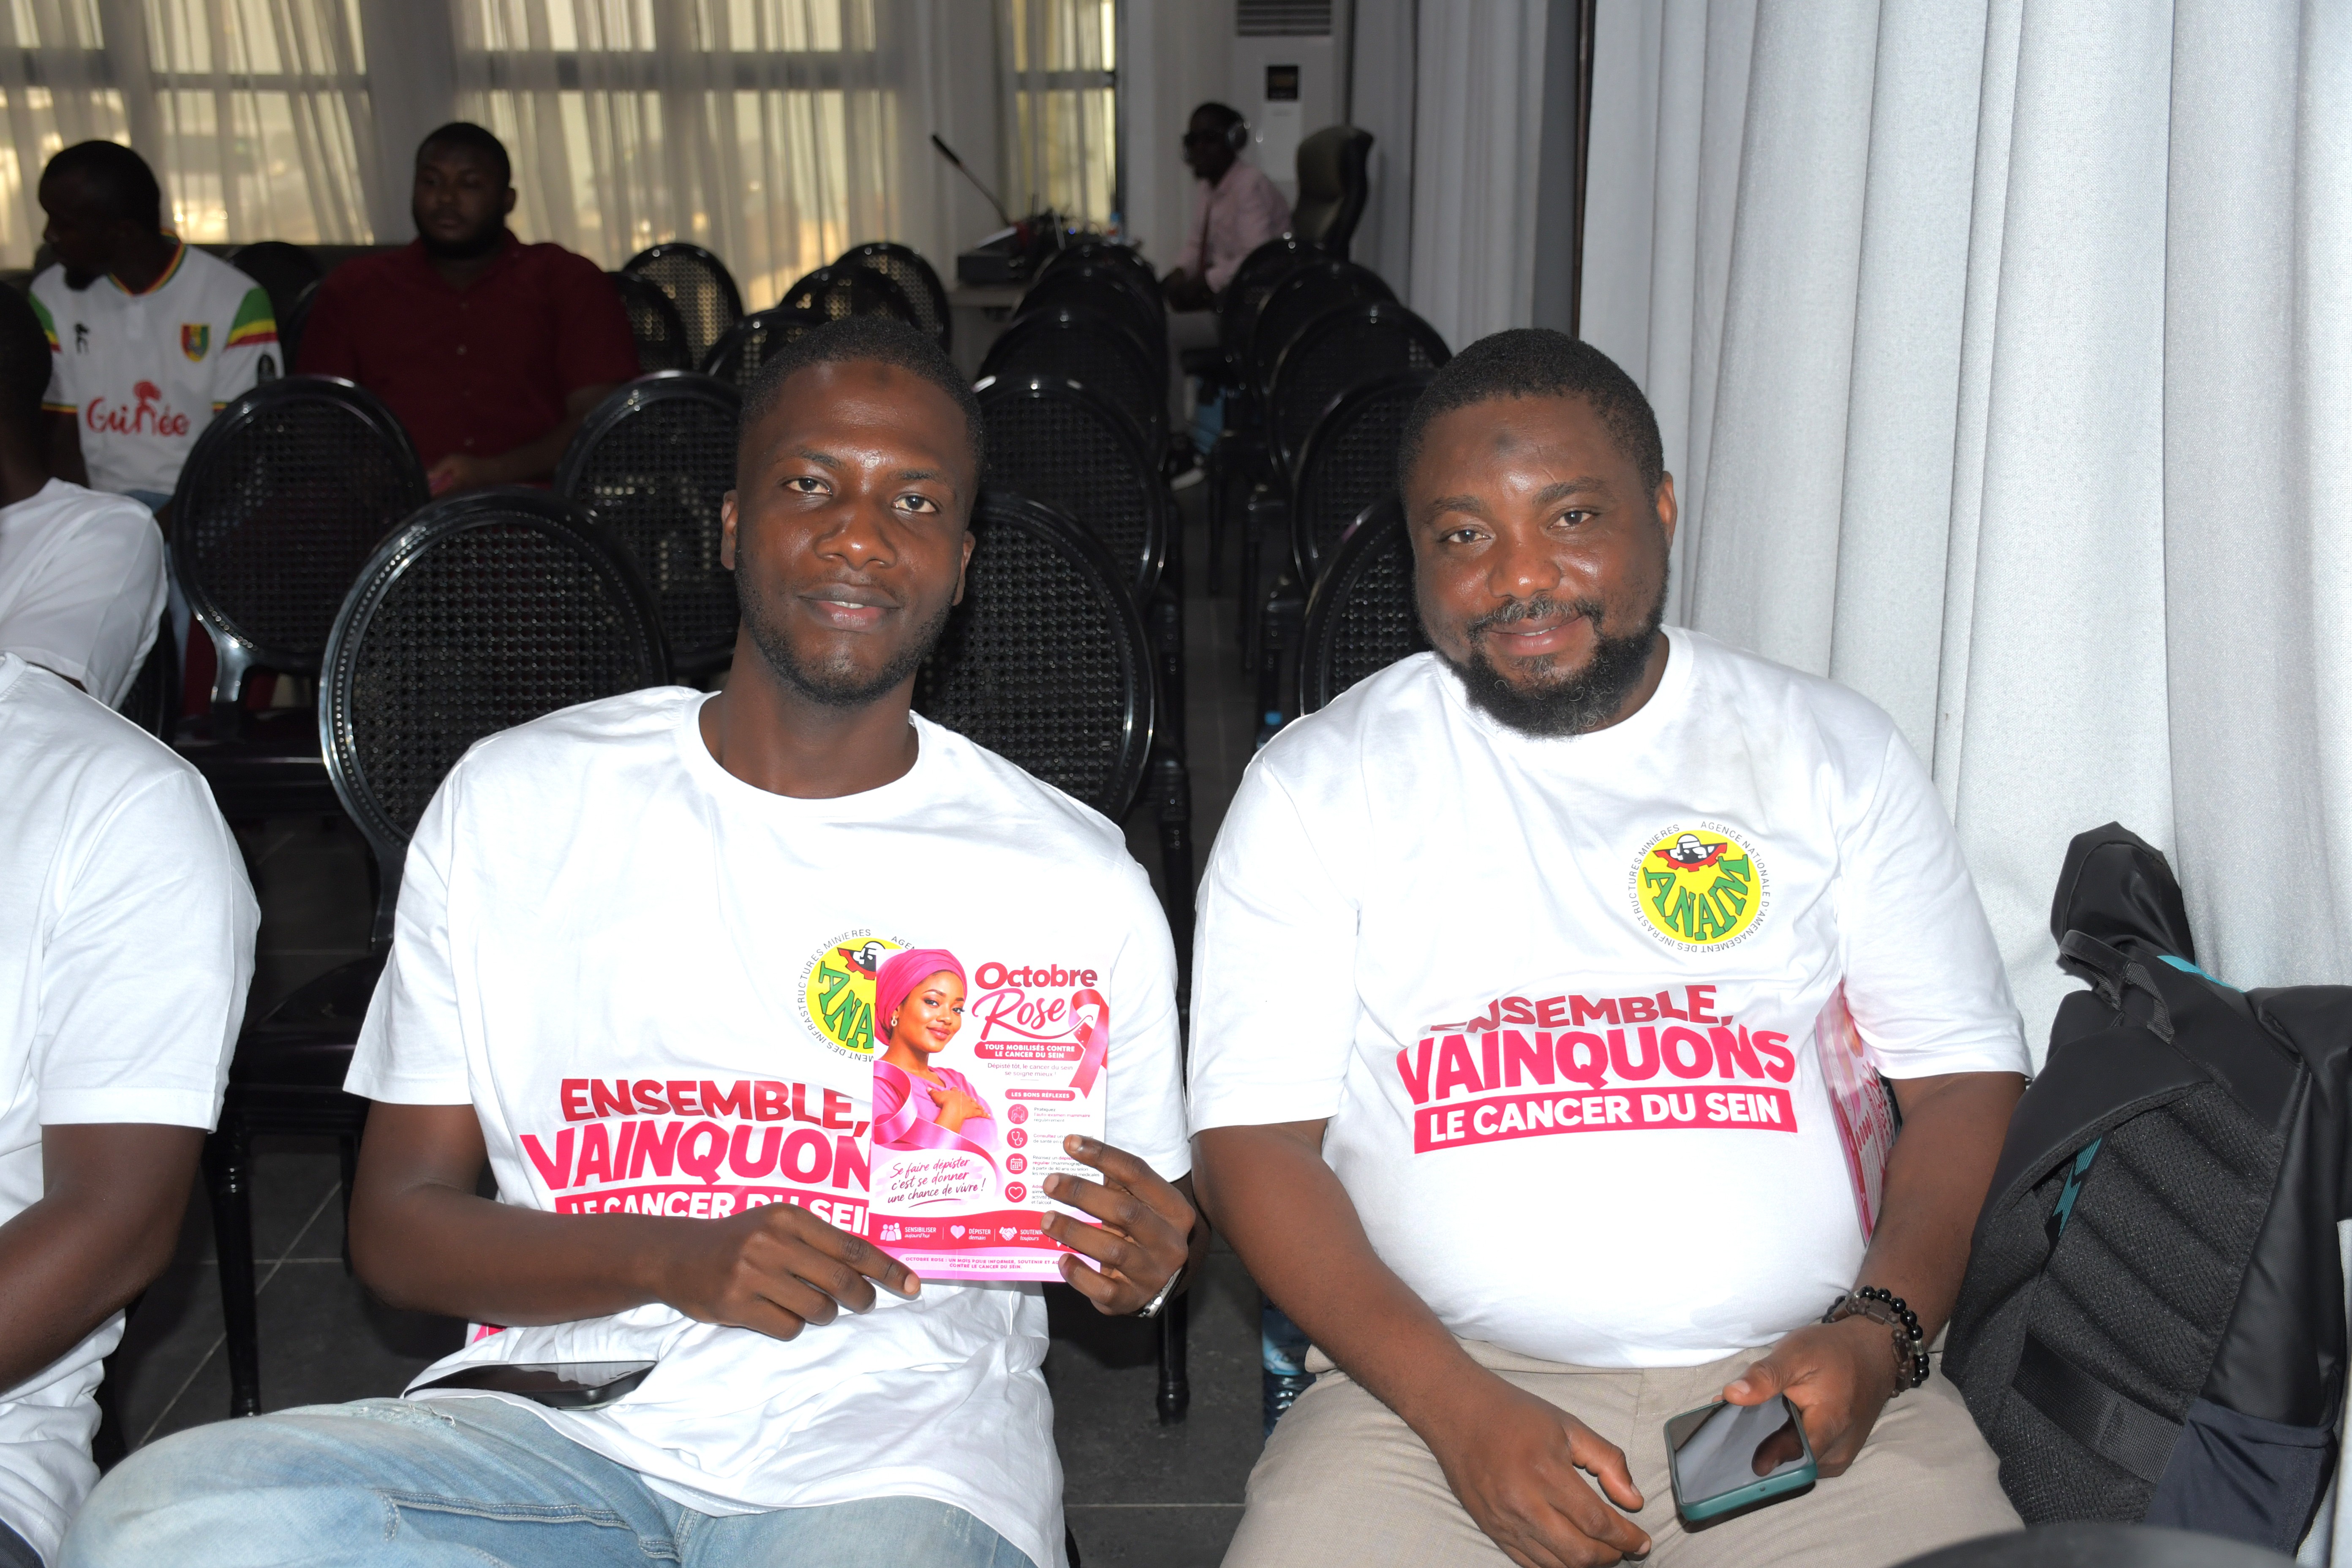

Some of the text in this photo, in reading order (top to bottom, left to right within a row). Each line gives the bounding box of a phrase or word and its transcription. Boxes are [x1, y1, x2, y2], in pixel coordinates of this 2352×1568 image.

[87, 381, 190, 436] Guinée
[1629, 821, 1770, 953] AGENCE NATIONALE D'AMENAGEMENT DES INFRASTRUCTURES MINIERES
[1643, 854, 1750, 941] ANAIM
[824, 929, 871, 950] MINIERES
[798, 949, 827, 1043] INFRASTRUCTURES
[975, 962, 1097, 990] Octobre
[818, 961, 875, 1049] ANA
[972, 988, 1093, 1040] Rose
[826, 1041, 845, 1056] DES
[1396, 1022, 1796, 1105] VAINQUONS
[561, 1078, 871, 1138] ENSEMBLE,
[1430, 1093, 1782, 1143] LE CANCER DU SEIN
[519, 1120, 871, 1192] VAINQUON
[890, 1156, 970, 1179] Se faire dépister
[892, 1171, 969, 1190] c'est se donner
[604, 1191, 736, 1220] CANCER
[810, 1199, 869, 1237] SEI
[887, 1194, 905, 1203] une
[908, 1188, 939, 1200] chance
[942, 1183, 952, 1196] de
[956, 1182, 978, 1193] vivre
